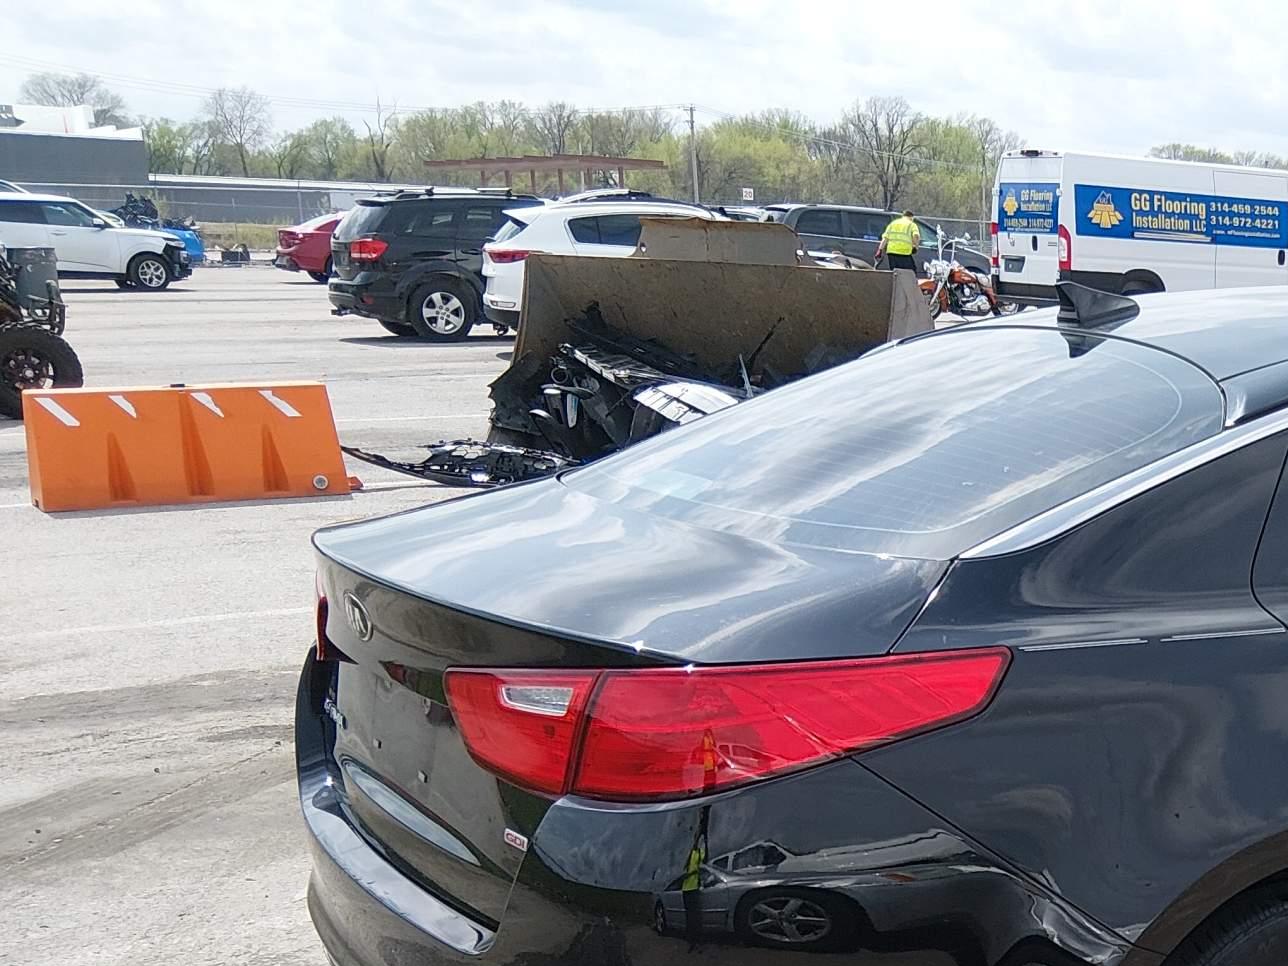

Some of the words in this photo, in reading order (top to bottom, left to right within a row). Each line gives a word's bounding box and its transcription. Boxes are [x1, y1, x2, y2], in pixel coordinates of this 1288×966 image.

[1131, 192, 1150, 211] GG
[1154, 194, 1206, 219] Flooring
[1210, 202, 1279, 216] 314-459-2544
[1132, 211, 1190, 231] Installation
[1193, 219, 1207, 232] LLC
[1210, 216, 1279, 229] 314-972-4221
